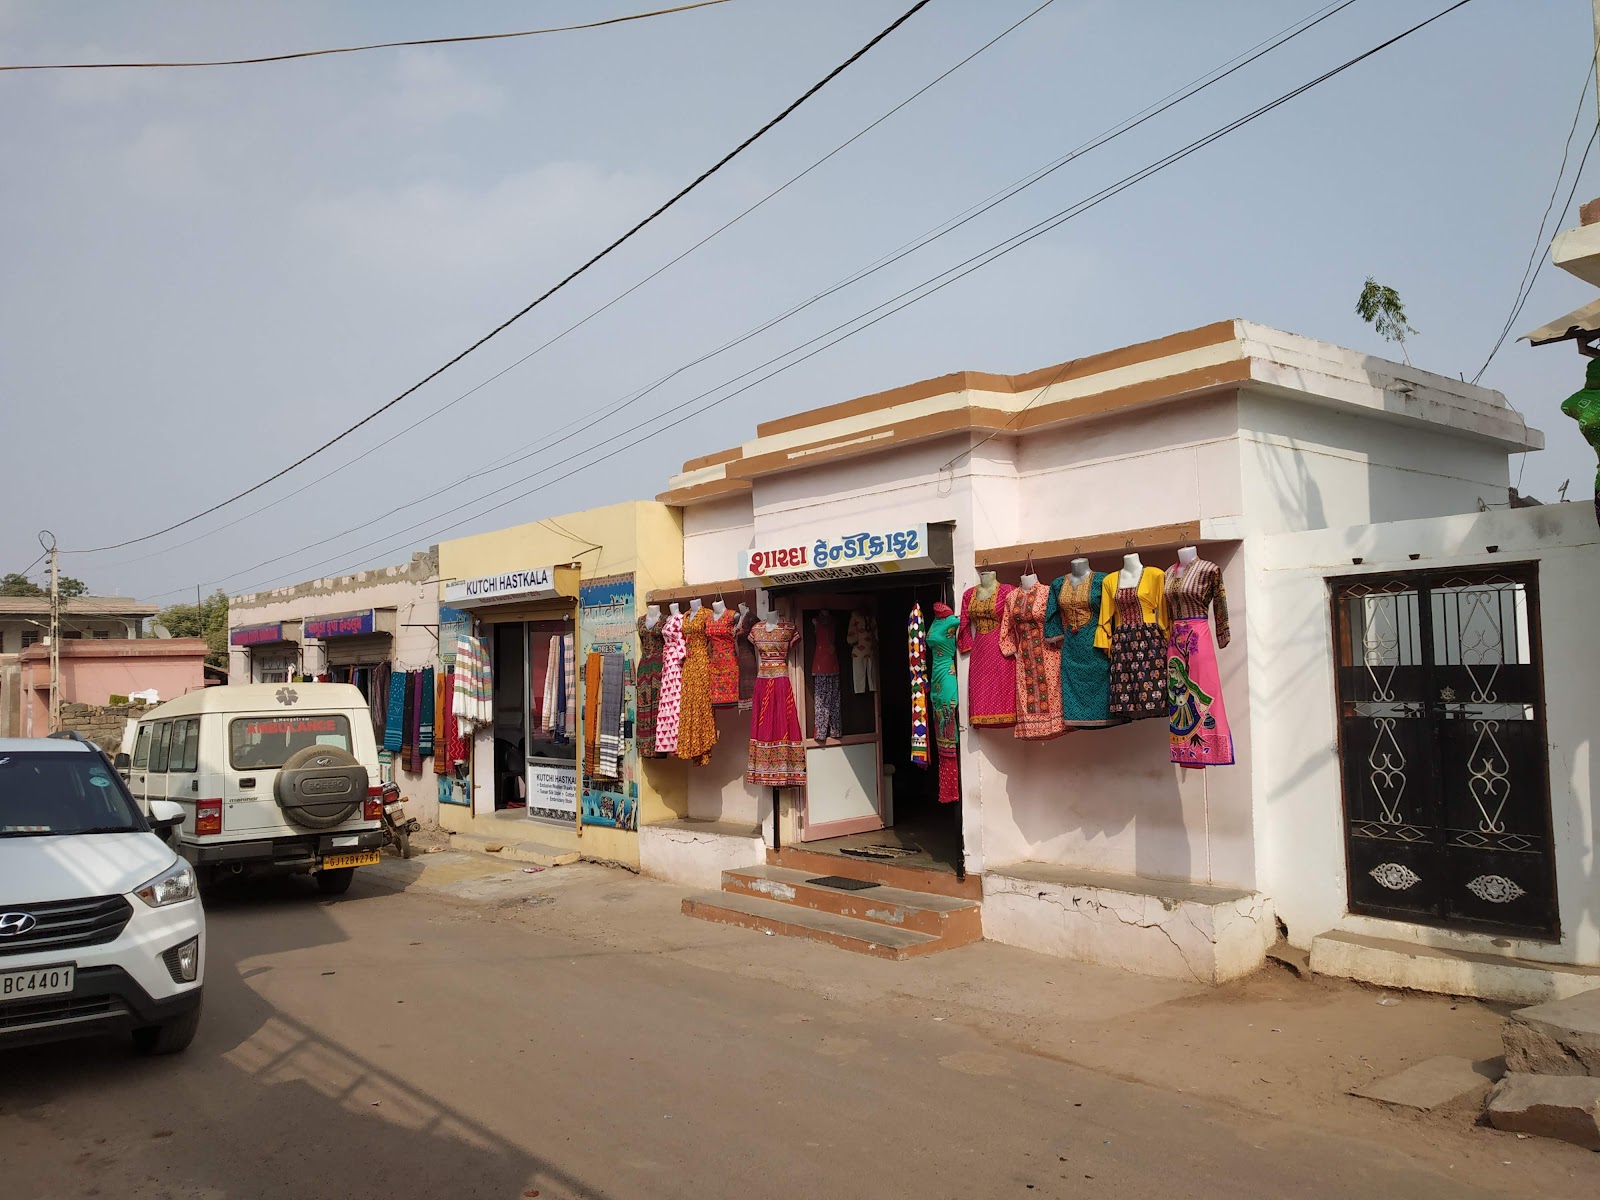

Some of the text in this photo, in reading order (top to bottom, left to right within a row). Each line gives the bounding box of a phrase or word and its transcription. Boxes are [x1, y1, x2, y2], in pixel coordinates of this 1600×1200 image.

[749, 546, 807, 576] શારદા
[466, 579, 498, 595] KUTCHI
[499, 569, 549, 591] HASTKALA
[597, 644, 617, 653] DRESS
[246, 719, 337, 735] AMBULANCE
[536, 773, 554, 782] KUTCHI
[3, 969, 70, 994] BC4401
